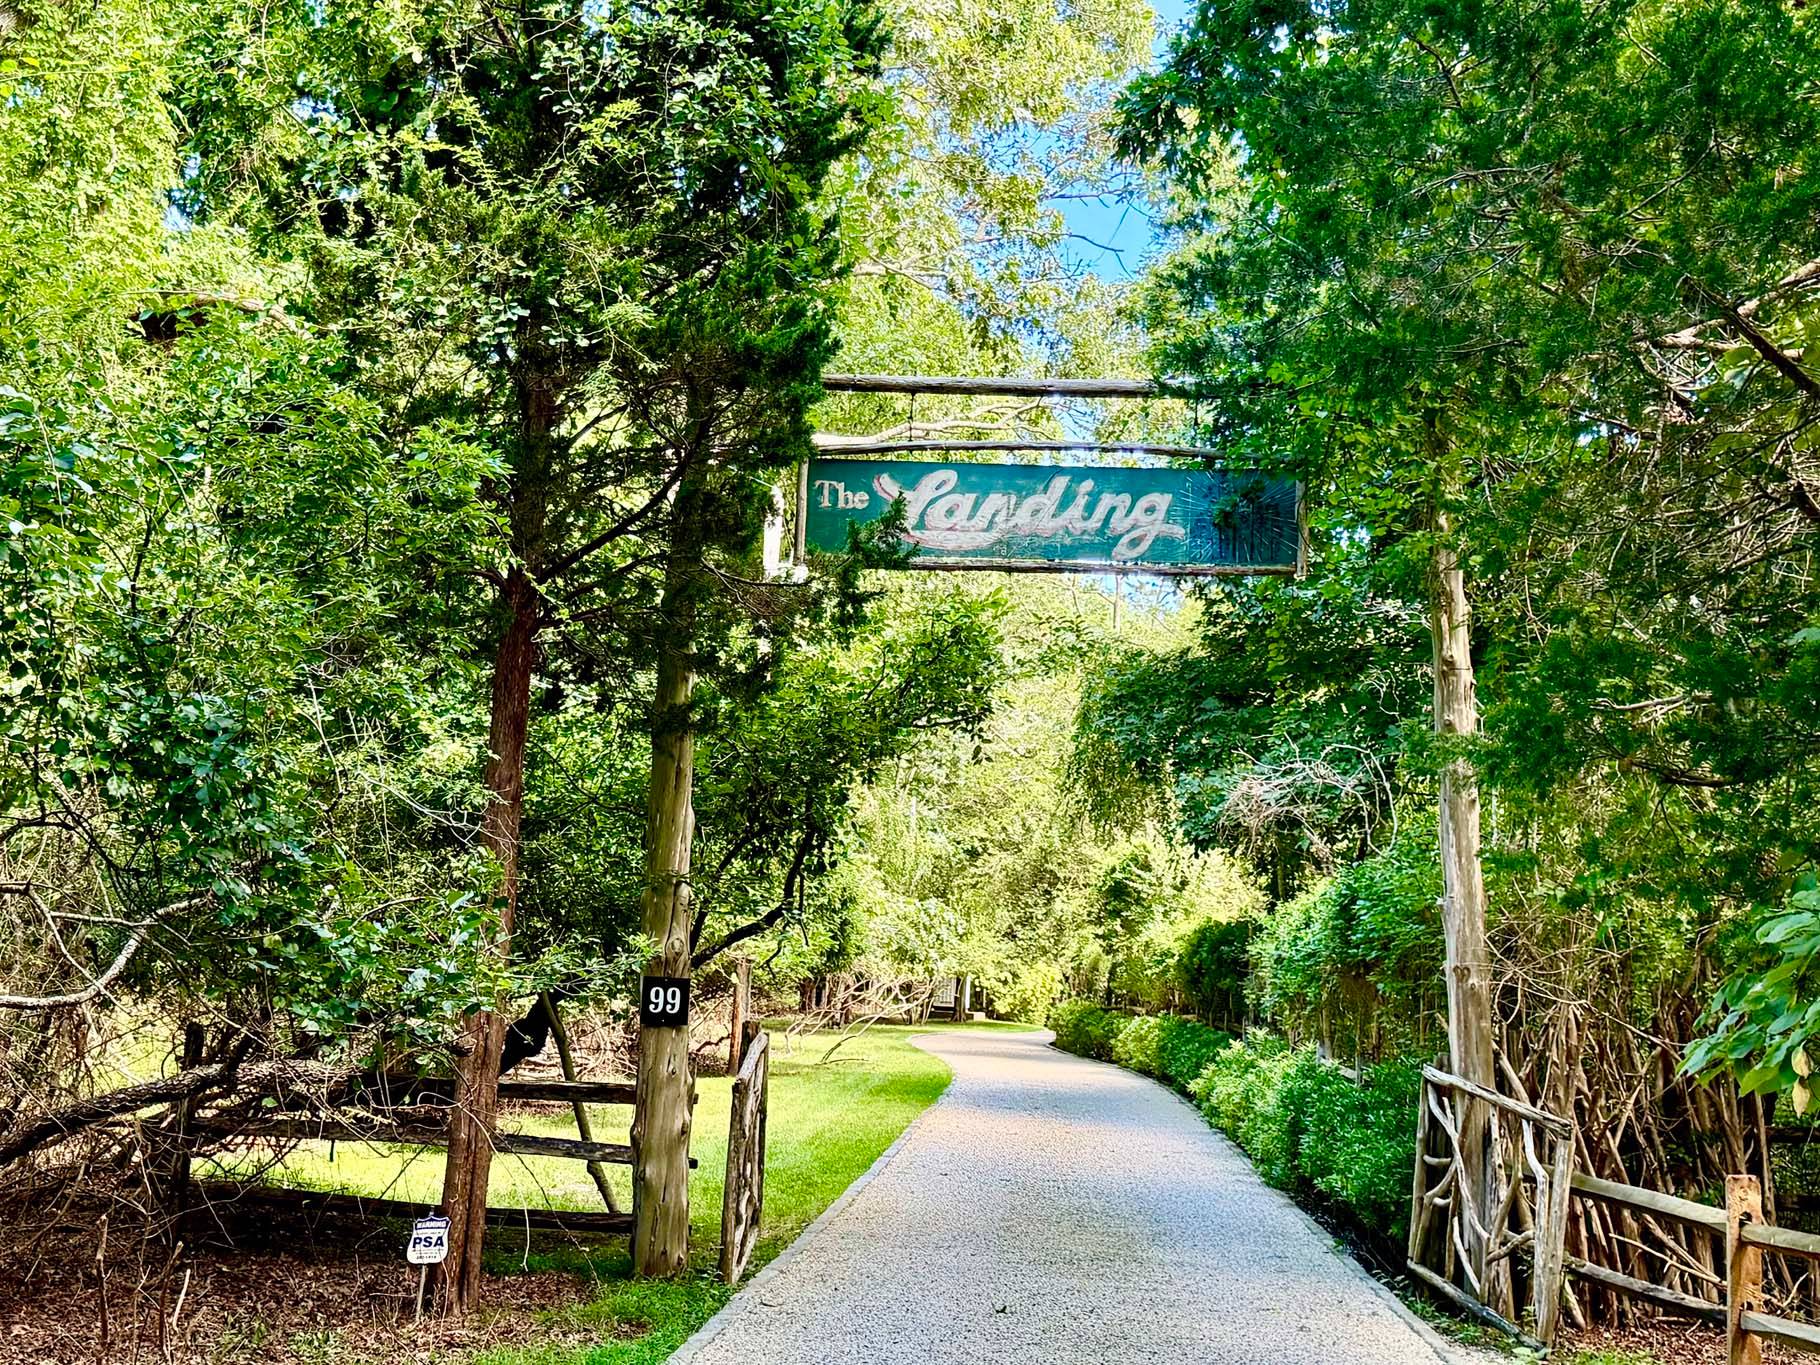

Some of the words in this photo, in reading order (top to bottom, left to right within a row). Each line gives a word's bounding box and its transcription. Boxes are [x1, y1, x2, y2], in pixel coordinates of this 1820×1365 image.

[813, 479, 870, 510] The
[873, 469, 1185, 560] Landing
[649, 986, 681, 1014] 99
[413, 1236, 444, 1248] PSA
